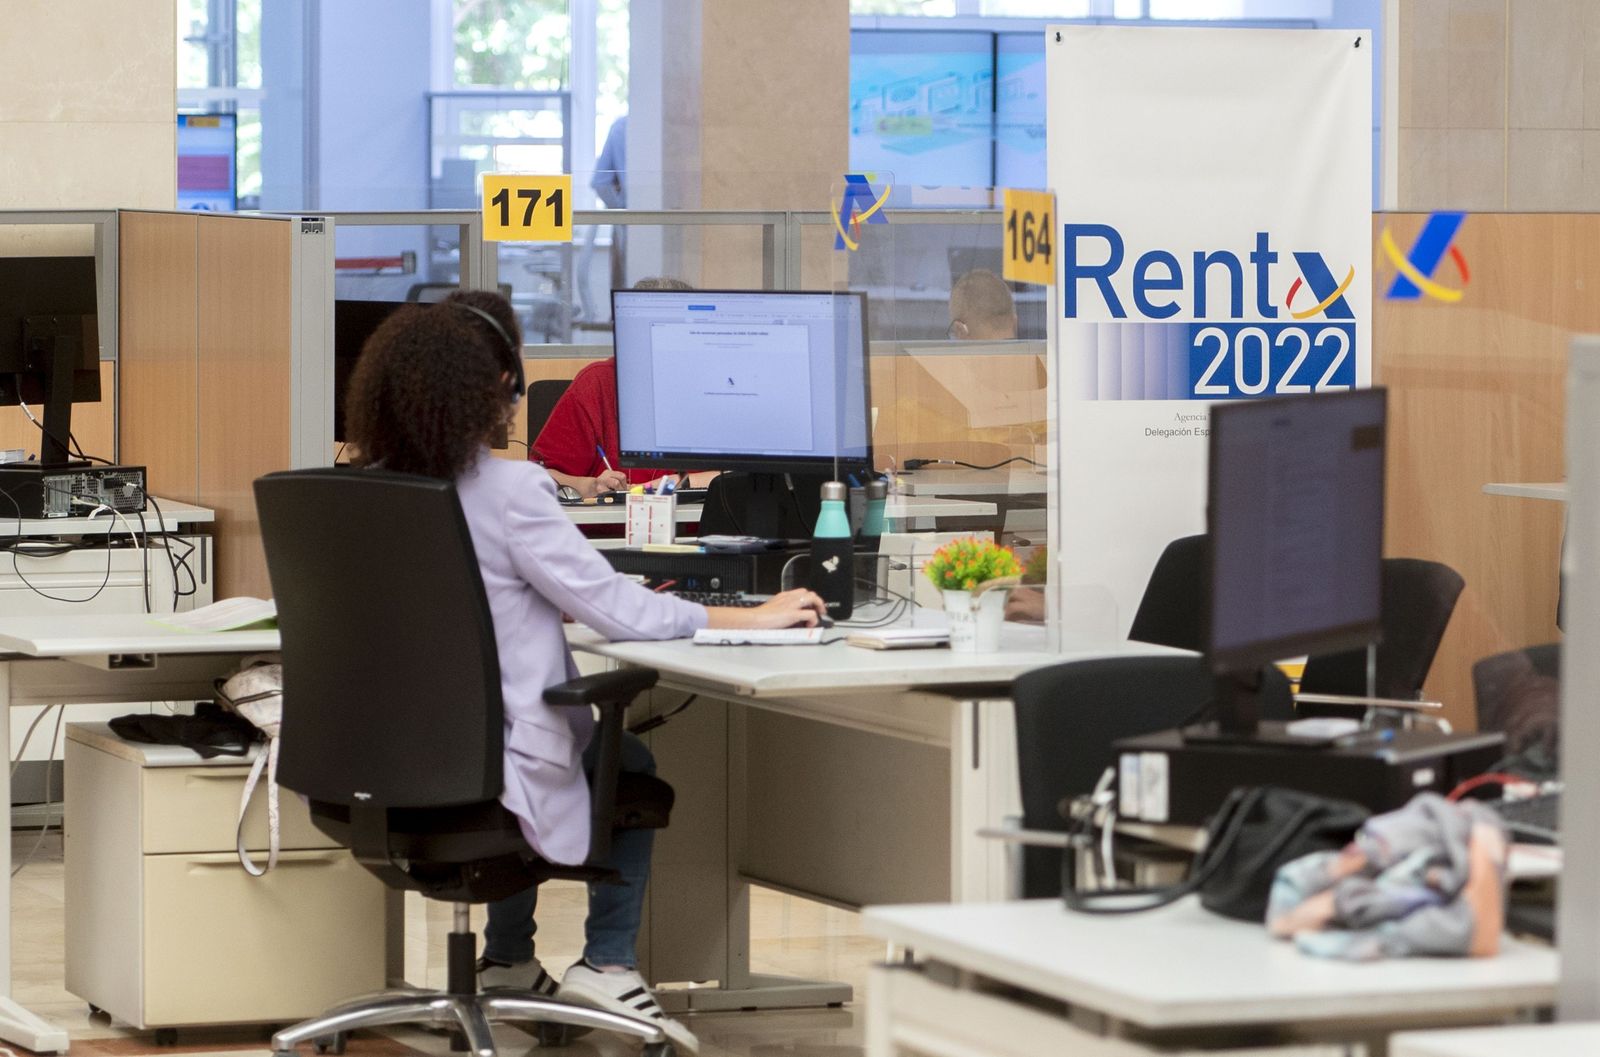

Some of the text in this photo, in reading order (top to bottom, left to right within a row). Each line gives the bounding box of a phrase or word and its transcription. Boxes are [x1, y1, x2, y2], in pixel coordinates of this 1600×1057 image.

[492, 188, 563, 227] 171
[1007, 209, 1052, 265] 164
[1193, 327, 1350, 394] 2022
[1144, 426, 1192, 438] Delegación
[1174, 411, 1207, 424] Agencia
